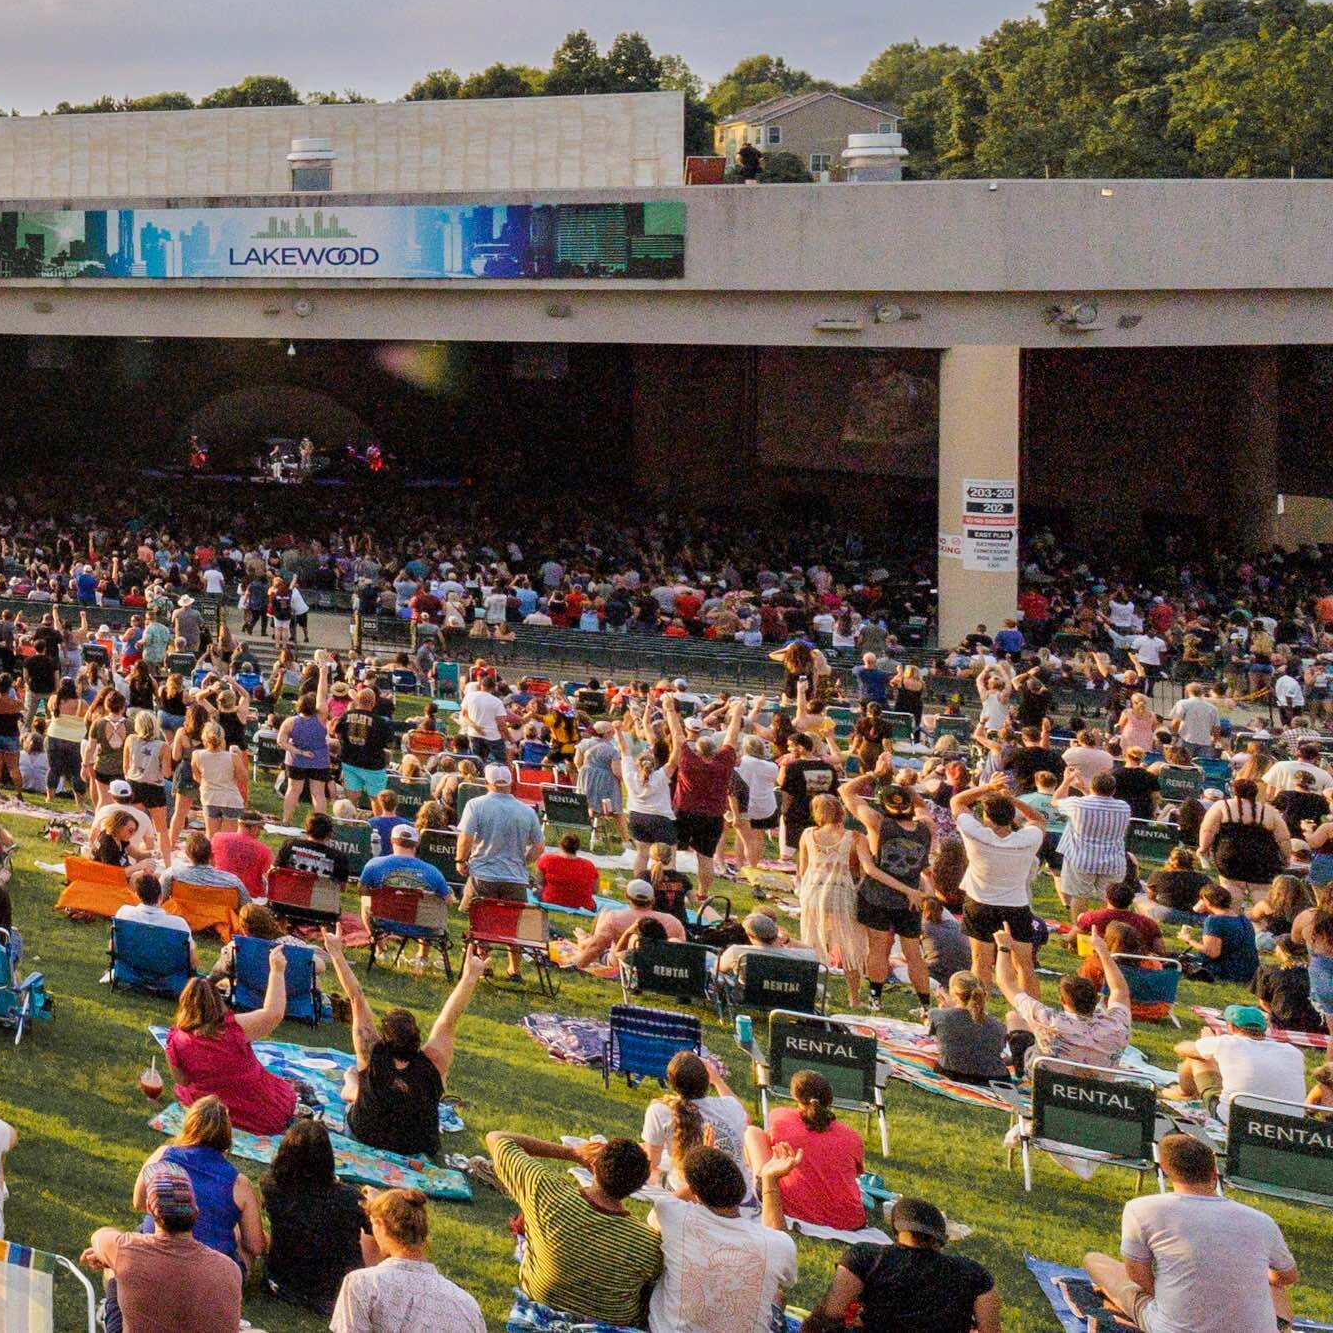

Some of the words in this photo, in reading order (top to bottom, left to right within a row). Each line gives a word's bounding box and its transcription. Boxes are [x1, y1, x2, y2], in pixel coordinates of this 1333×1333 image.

[229, 247, 379, 266] LAKEWOOD
[983, 503, 1004, 513] 202
[1165, 779, 1195, 789] RENTAL
[397, 794, 423, 805] ENTAL
[548, 794, 580, 805] RENTAL
[1133, 829, 1171, 840] RENTAL
[329, 839, 361, 854] ENTAL
[429, 843, 456, 854] RENT
[653, 965, 690, 979] RENTAL
[762, 979, 801, 992] RENTAL
[786, 1036, 858, 1059] RENTAL
[1052, 1083, 1135, 1110] RENTAL
[1247, 1121, 1333, 1148] RENTAL
